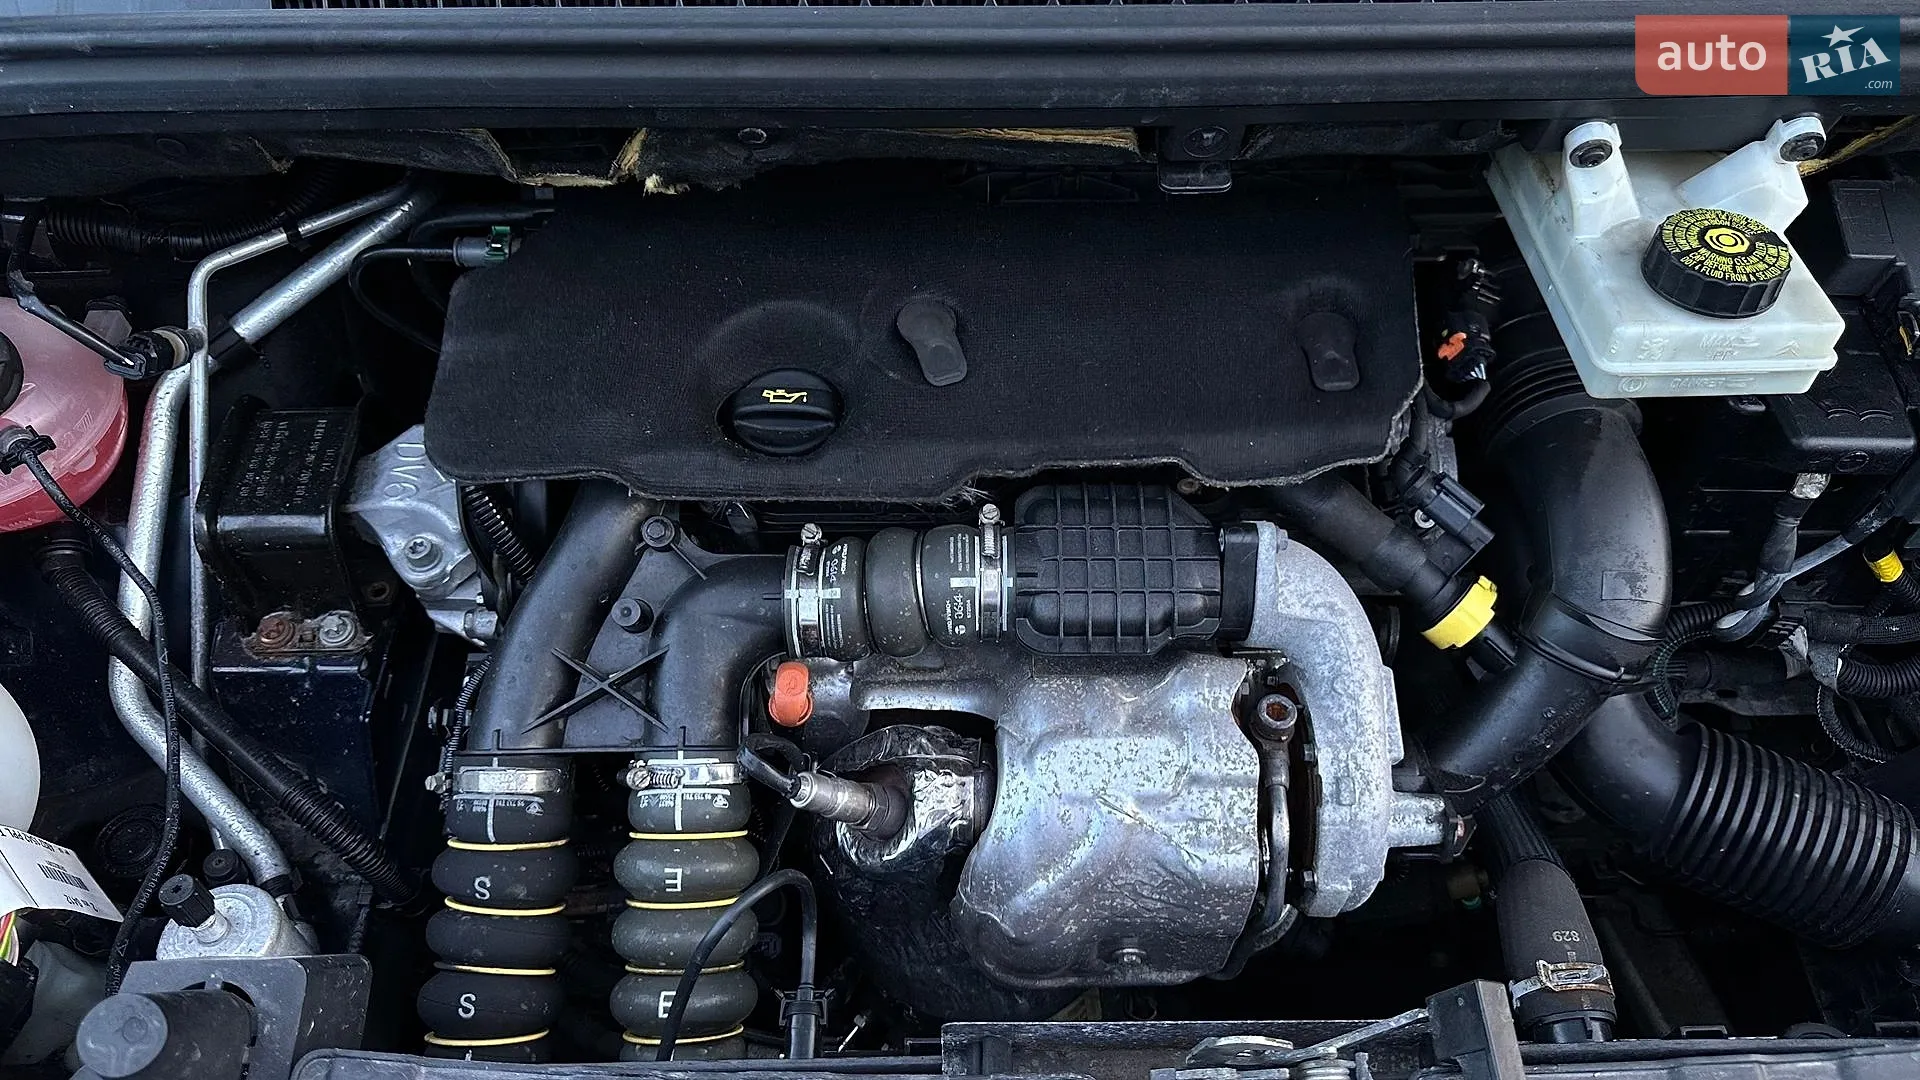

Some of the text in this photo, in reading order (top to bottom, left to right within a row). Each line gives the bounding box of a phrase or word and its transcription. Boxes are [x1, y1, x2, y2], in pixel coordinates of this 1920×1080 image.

[1689, 252, 1705, 262] CAP
[1704, 259, 1733, 273] BEFORE
[1698, 247, 1734, 264] WARNING
[1734, 254, 1759, 266] CLEAN
[1680, 257, 1696, 267] DOT
[1700, 267, 1724, 279] FLUID
[1725, 272, 1748, 282] FROM
[1749, 274, 1757, 282] A
[1756, 267, 1781, 281] SEALED
[383, 443, 425, 500] DV6
[473, 876, 491, 901] S
[664, 868, 683, 892] E
[1552, 930, 1580, 942] 829
[457, 994, 477, 1019] S
